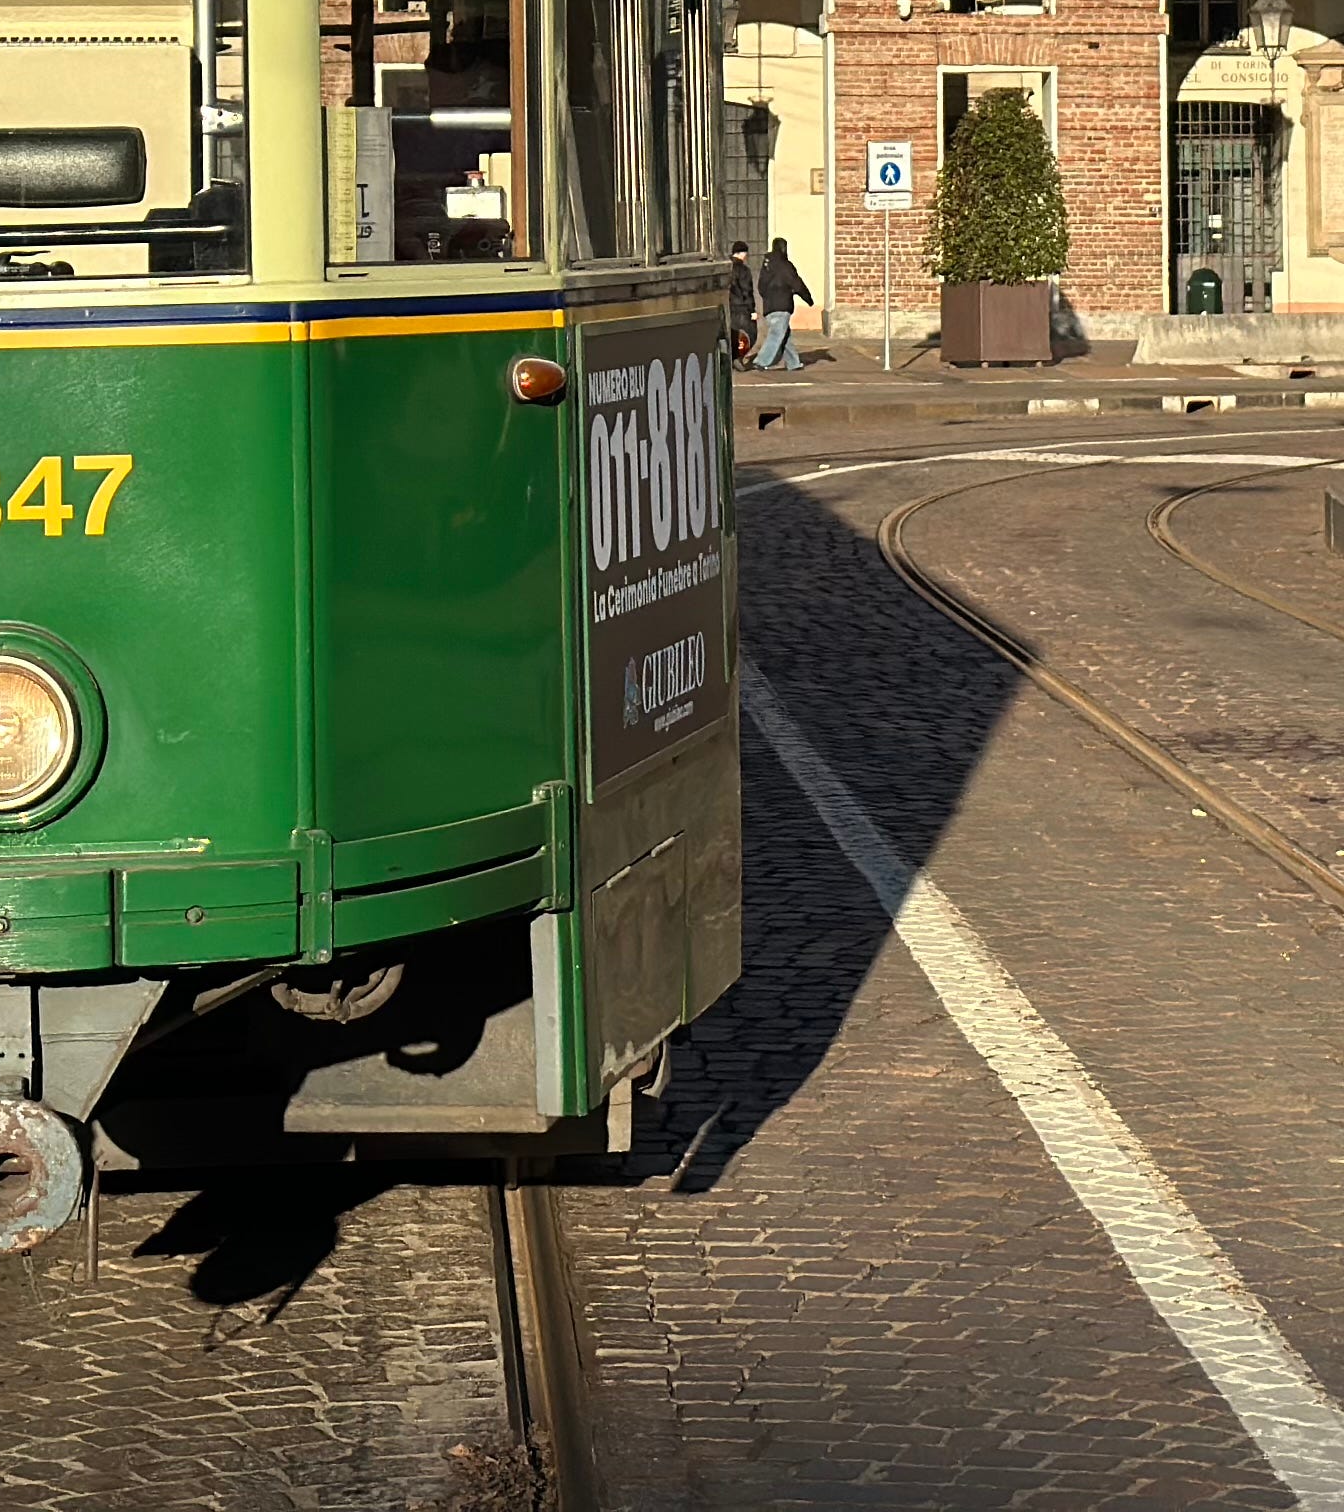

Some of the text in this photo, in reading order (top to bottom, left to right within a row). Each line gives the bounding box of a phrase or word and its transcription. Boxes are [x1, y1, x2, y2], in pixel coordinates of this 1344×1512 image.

[1236, 61, 1274, 69] TORIN
[589, 364, 645, 406] NUMERO BLU
[590, 352, 719, 572] 011-8181
[593, 590, 606, 624] La
[607, 568, 657, 618] Cerimonia
[657, 559, 691, 599] Funebre
[642, 631, 705, 714] GIUBILEO
